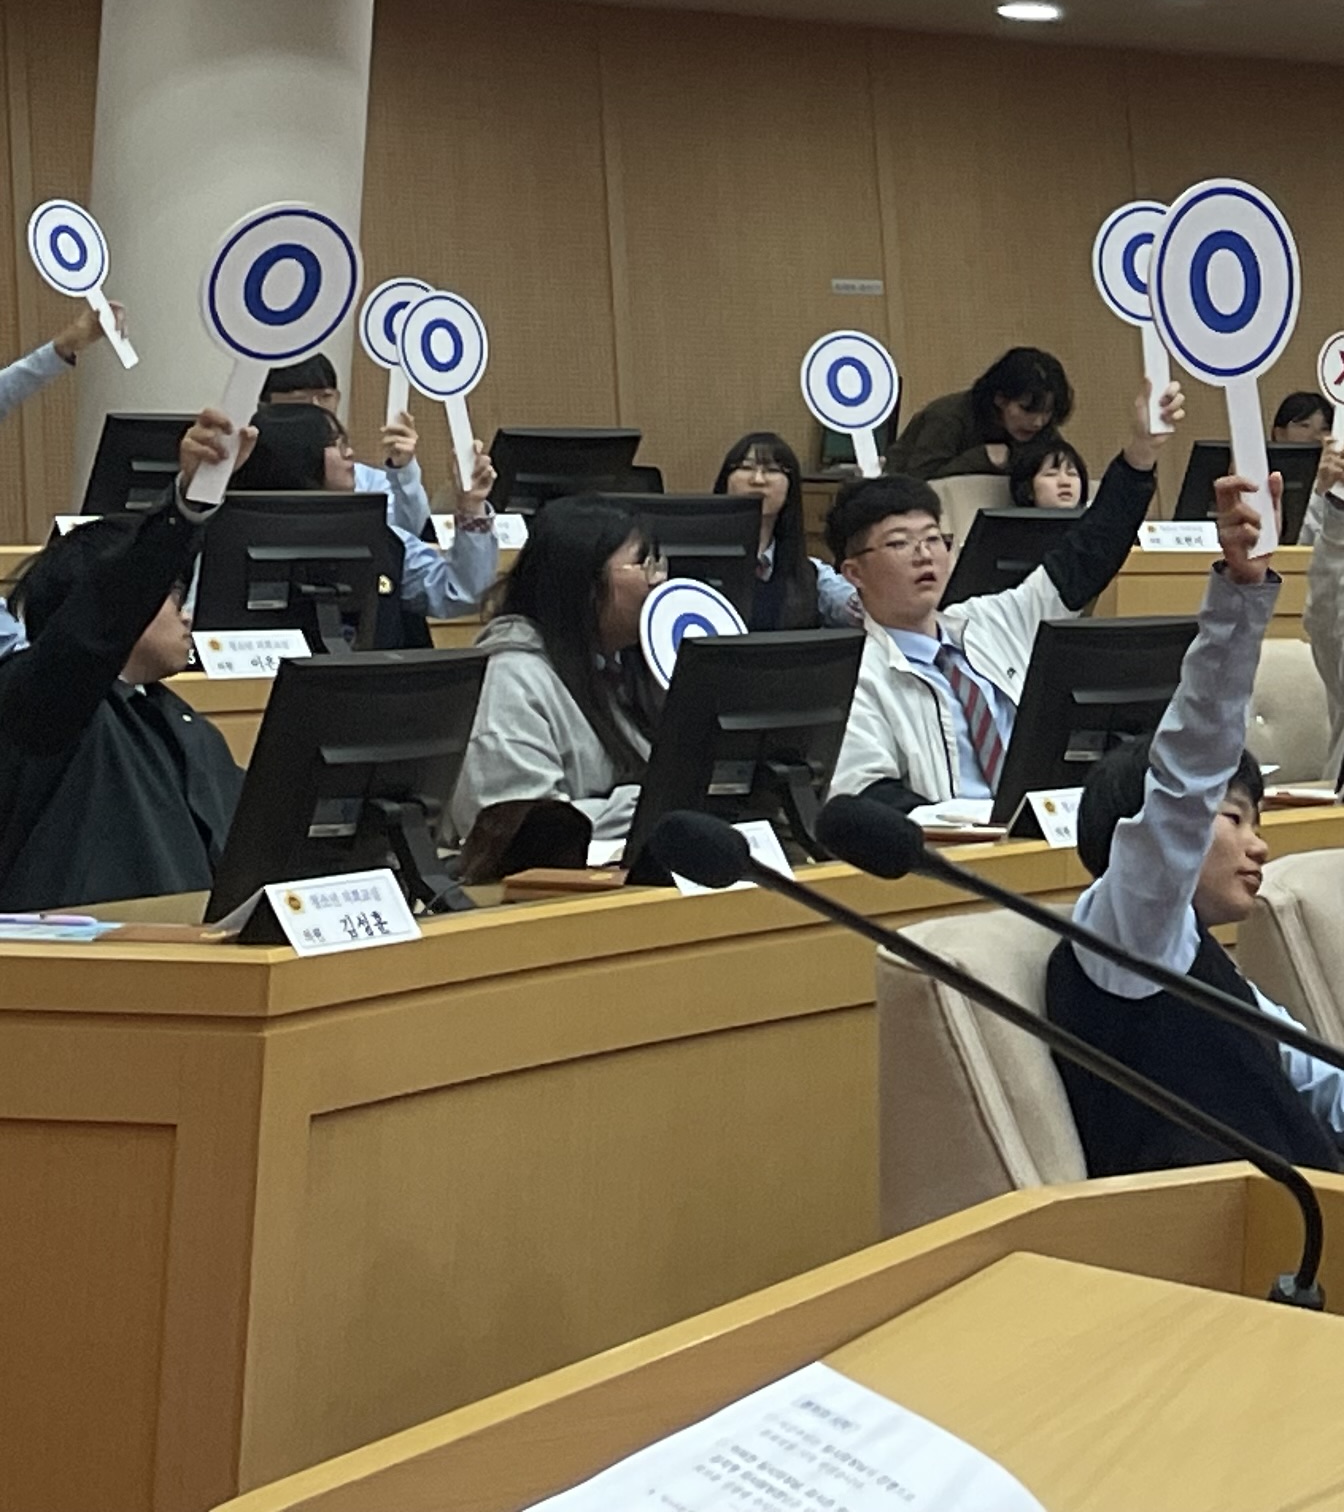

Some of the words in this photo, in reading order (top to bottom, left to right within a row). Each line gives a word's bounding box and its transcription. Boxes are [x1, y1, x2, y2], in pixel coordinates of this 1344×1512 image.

[49, 224, 87, 271] O
[244, 244, 320, 325] O
[1190, 230, 1260, 333] O
[421, 318, 463, 372] O
[827, 356, 872, 406] O
